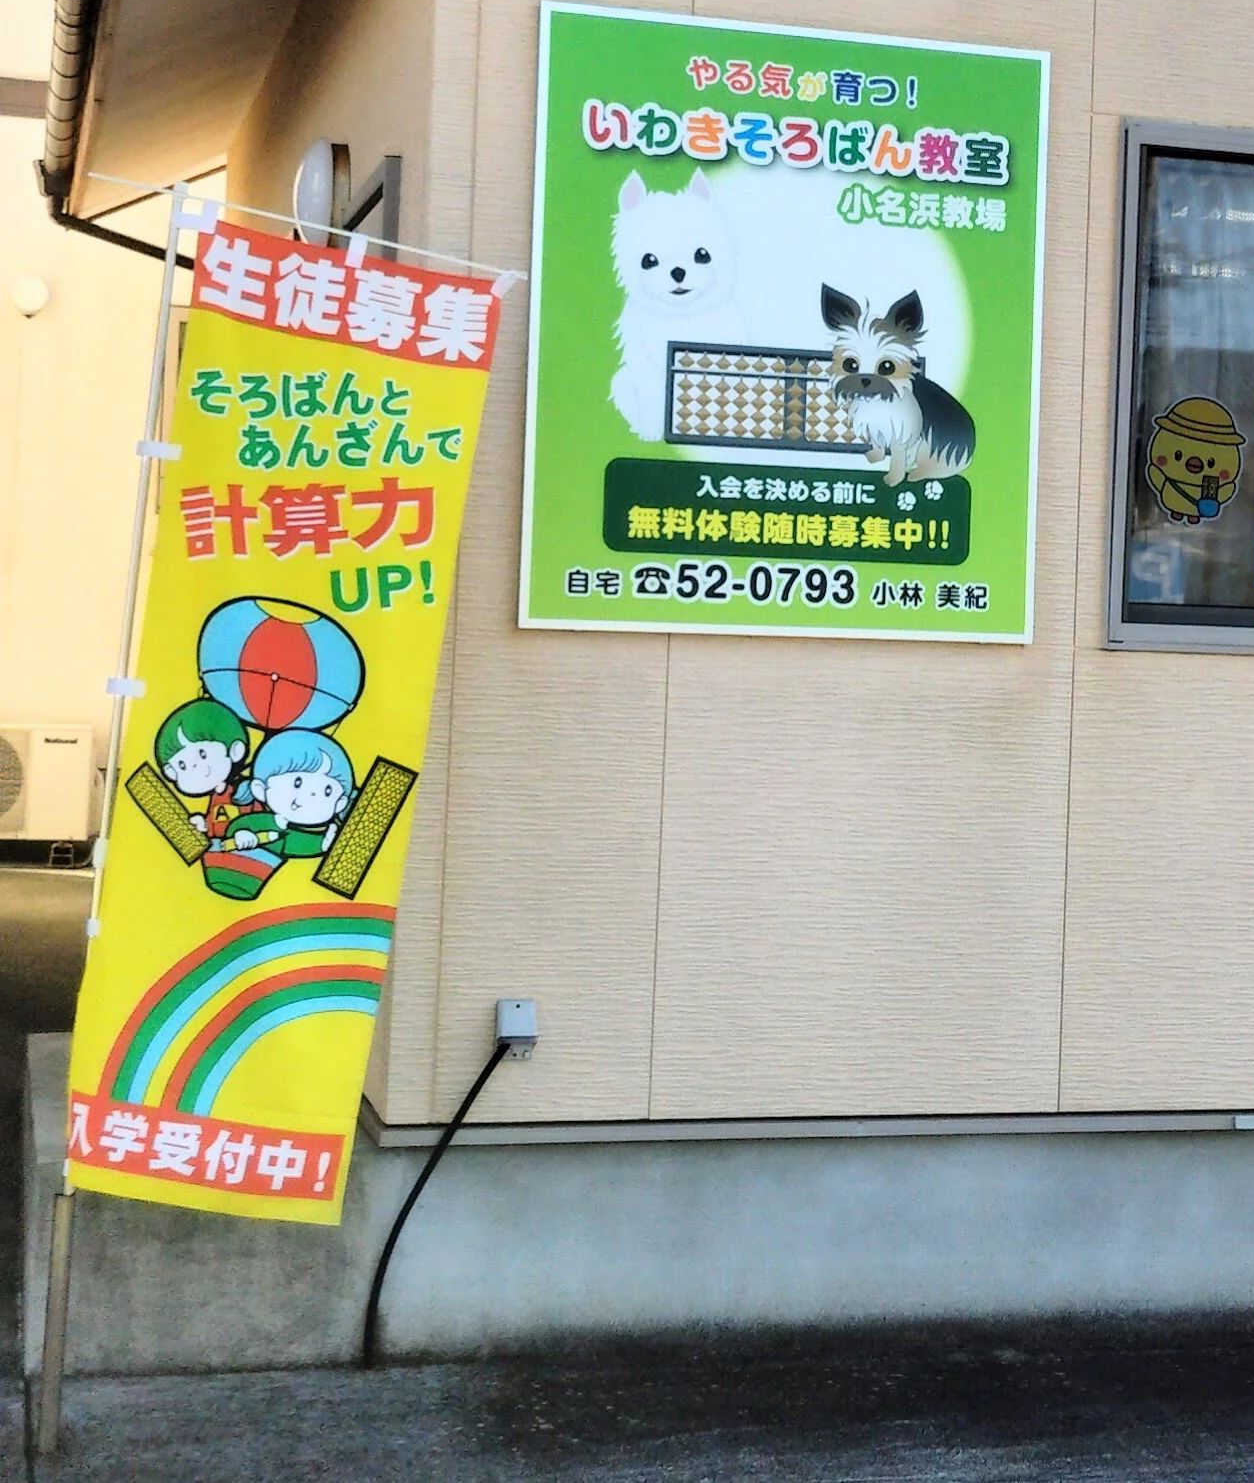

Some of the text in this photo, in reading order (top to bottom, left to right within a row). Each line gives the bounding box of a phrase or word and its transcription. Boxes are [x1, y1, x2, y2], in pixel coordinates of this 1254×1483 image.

[688, 58, 918, 107] やる気が育つ!
[586, 104, 1006, 181] いわきそろばん教室
[840, 186, 1007, 232] 小名浜教場
[199, 239, 494, 363] 生徒募集
[191, 370, 412, 419] そろばんと
[238, 421, 462, 469] あんざんで
[697, 476, 876, 505] 入会を決める前に
[180, 477, 436, 559] 計算力
[628, 506, 950, 551] 無料体験随時募集中!!
[331, 560, 437, 613] UP!
[567, 563, 988, 609] 自宅 52-0793 小林 美紀
